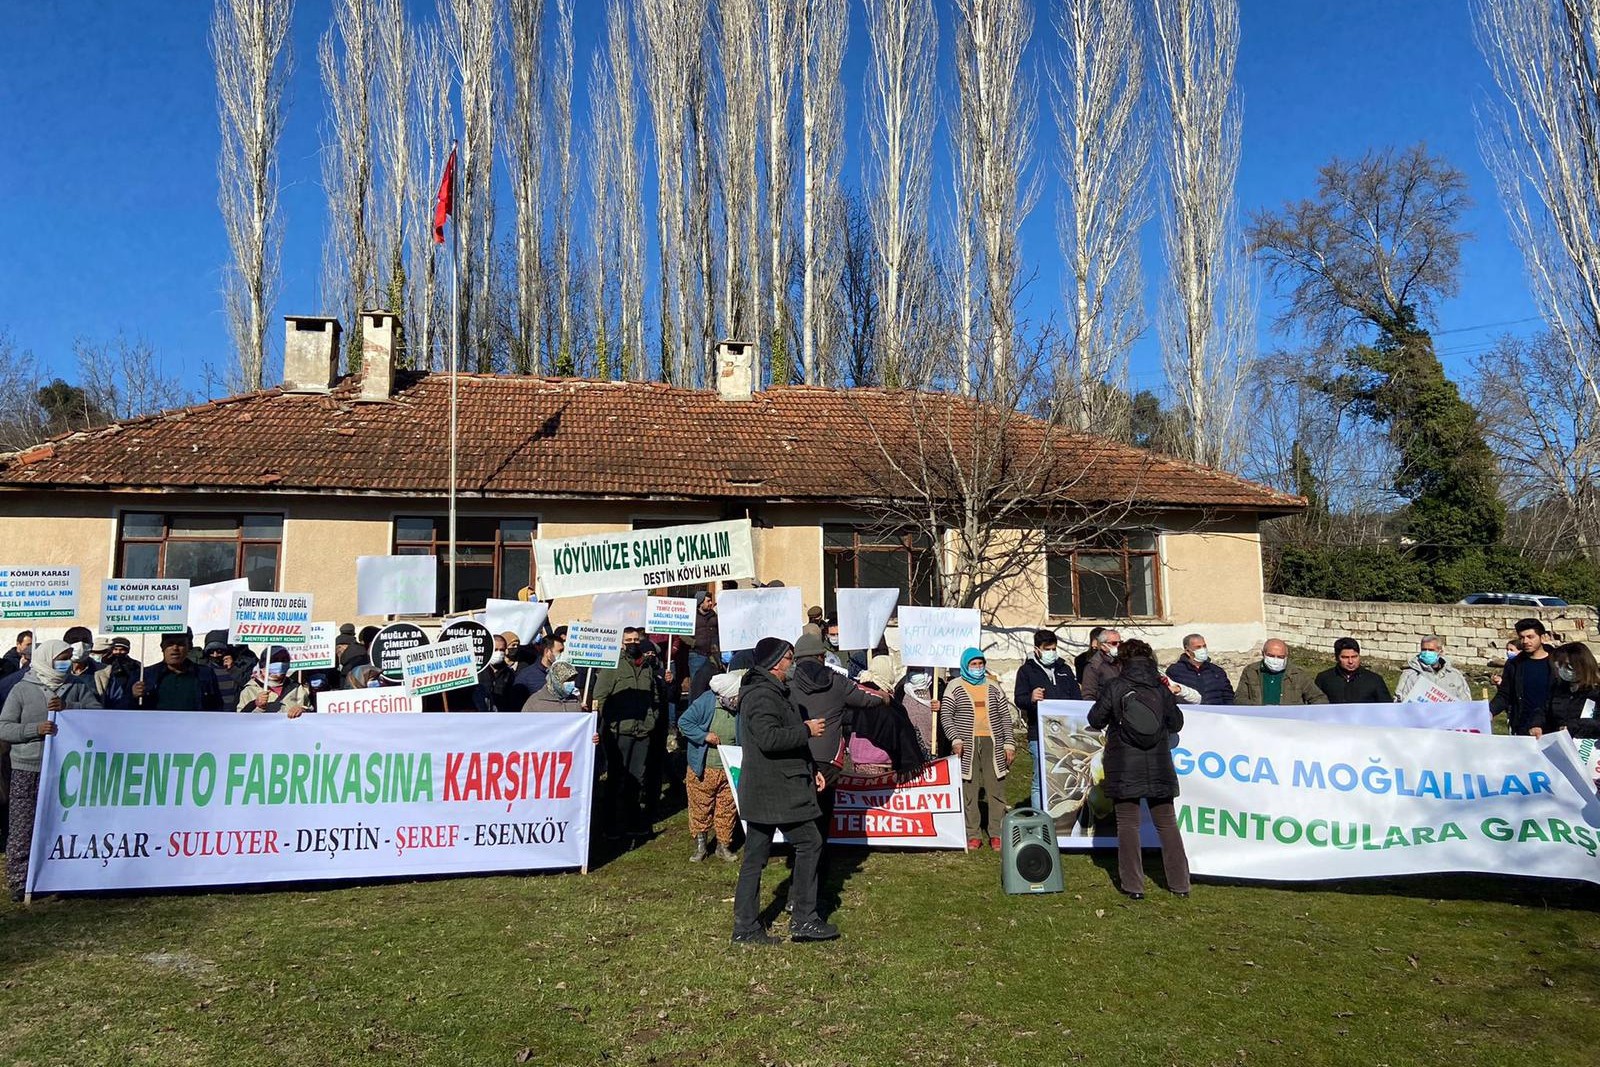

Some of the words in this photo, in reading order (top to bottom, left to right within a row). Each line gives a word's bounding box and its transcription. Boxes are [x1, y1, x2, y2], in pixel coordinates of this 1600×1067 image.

[553, 539, 629, 576] KÖYÜMÜZE
[633, 534, 673, 568] SAHİP
[677, 530, 731, 566] ÇIKALIM
[643, 568, 675, 586] DEŞTİN
[677, 565, 701, 582] KÖYÜ
[703, 563, 731, 579] HALKI
[238, 596, 269, 609] ÇİMENTO
[271, 598, 287, 608] TOZU
[289, 596, 307, 608] DEĞİL
[236, 609, 256, 620] TEMİZ
[258, 611, 275, 621] HAVA
[277, 611, 308, 621] SOLUMAK
[237, 622, 303, 634] İSTİYORUZ.
[411, 630, 422, 638] DA
[383, 639, 419, 649] ÇİMENTO
[406, 649, 434, 663] ÇİMENTO
[435, 646, 451, 657] TOZU
[452, 642, 469, 654] DEĞİL
[407, 664, 426, 676] TEMİZ
[427, 661, 443, 672] HAVA
[443, 655, 472, 668] SOLUMAK
[411, 667, 470, 688] İSTİYORUZ.
[58, 739, 218, 822] ÇİMENTO
[224, 742, 434, 806] FABRİKASINA
[442, 750, 574, 813] KARŞIYIZ
[1170, 747, 1280, 785] GOCA
[1292, 757, 1555, 800] MOĞLALILAR
[834, 814, 924, 834] TERKET!
[48, 831, 151, 867] ALAŞAR
[168, 830, 280, 857] SULUYER
[295, 822, 381, 859] DEŞTİN
[395, 825, 460, 857] ŞEREF
[474, 817, 570, 847] ESENKÖY
